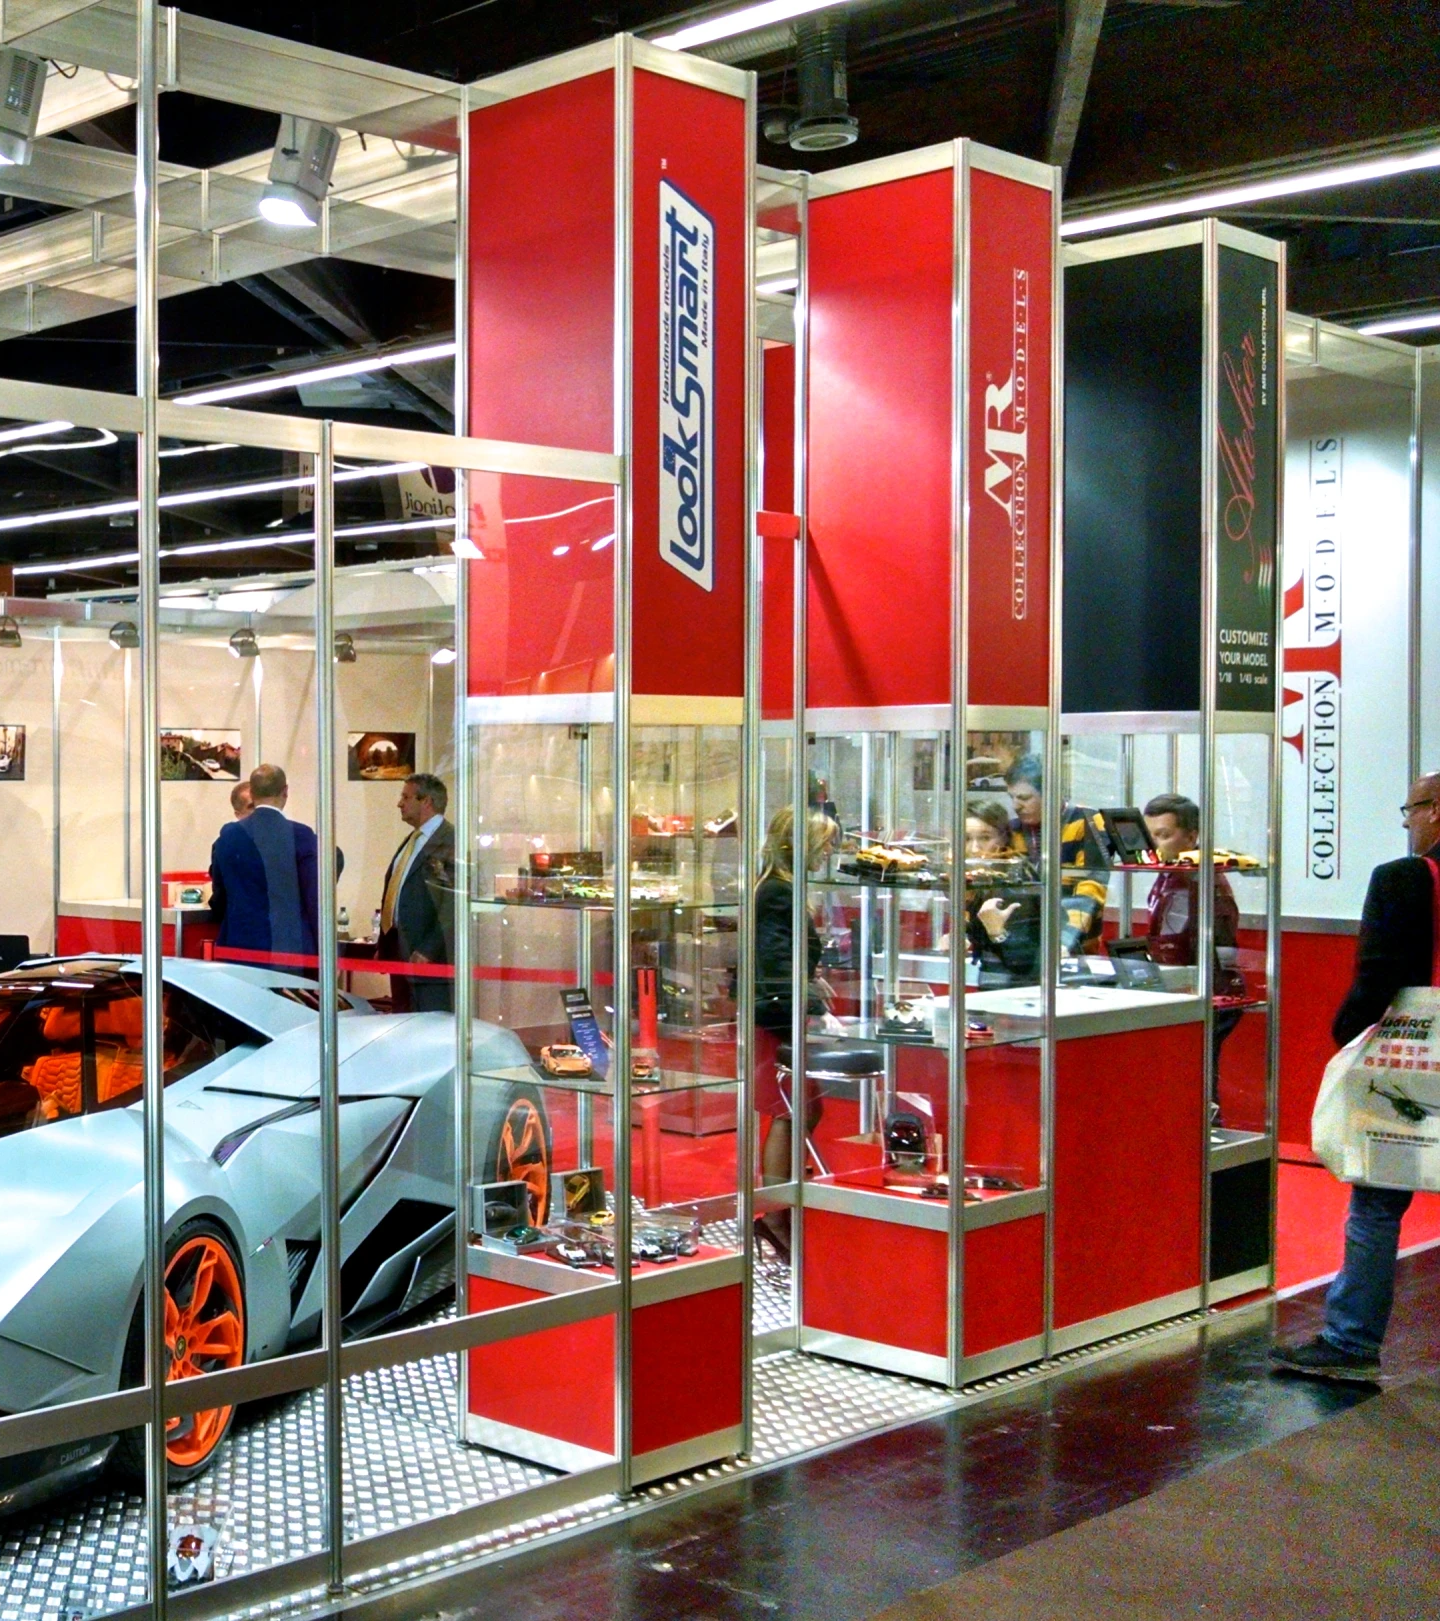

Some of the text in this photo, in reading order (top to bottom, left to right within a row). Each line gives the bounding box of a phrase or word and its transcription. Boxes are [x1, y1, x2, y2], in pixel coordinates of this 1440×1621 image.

[662, 244, 670, 404] Handmade models
[701, 233, 711, 349] Made in Italy
[665, 205, 704, 571] LookSmart
[984, 368, 1027, 526] MR
[1219, 628, 1269, 647] CUSTOMIZE
[1219, 651, 1269, 667] YOUR MODEL
[60, 1443, 91, 1466] CAUTION
